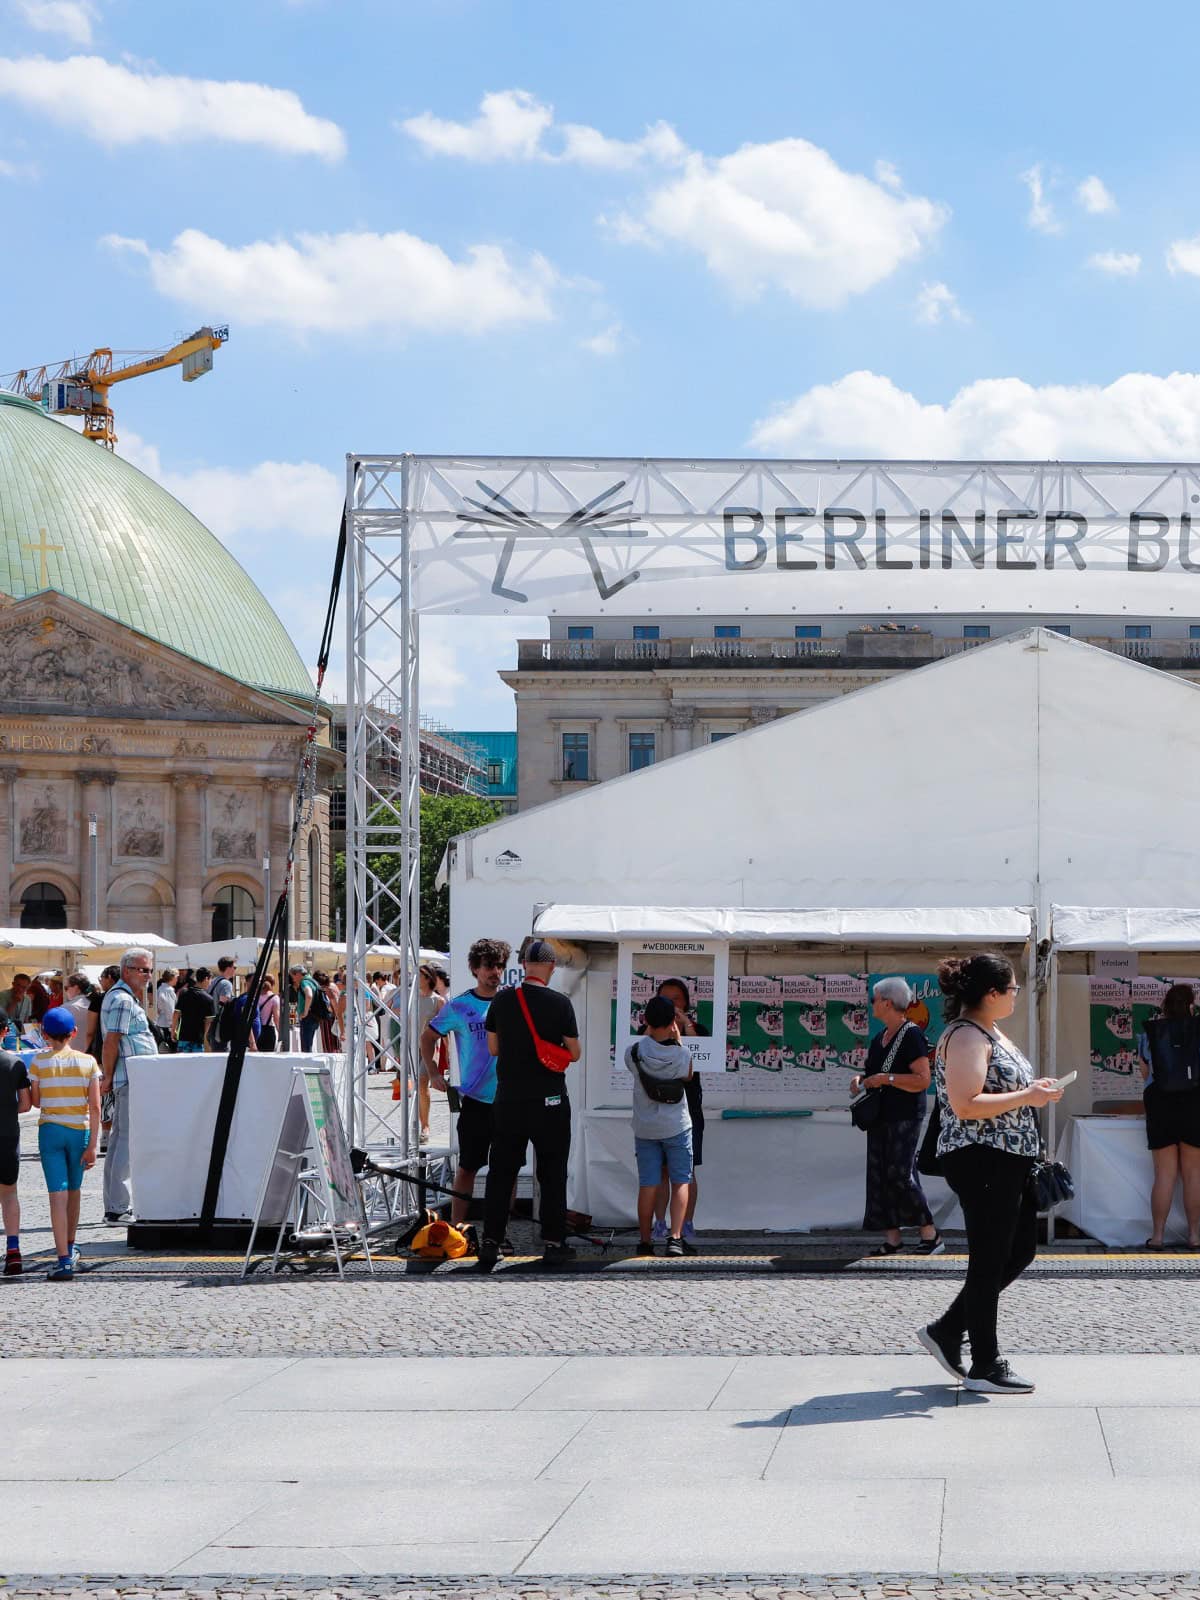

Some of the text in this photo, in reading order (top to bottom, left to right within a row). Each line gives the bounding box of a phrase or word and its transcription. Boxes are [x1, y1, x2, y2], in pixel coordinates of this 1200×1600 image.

[724, 507, 1088, 570] BERLINER
[642, 943, 705, 952] #WEBOOKBERLIN
[692, 1052, 711, 1061] FEST
